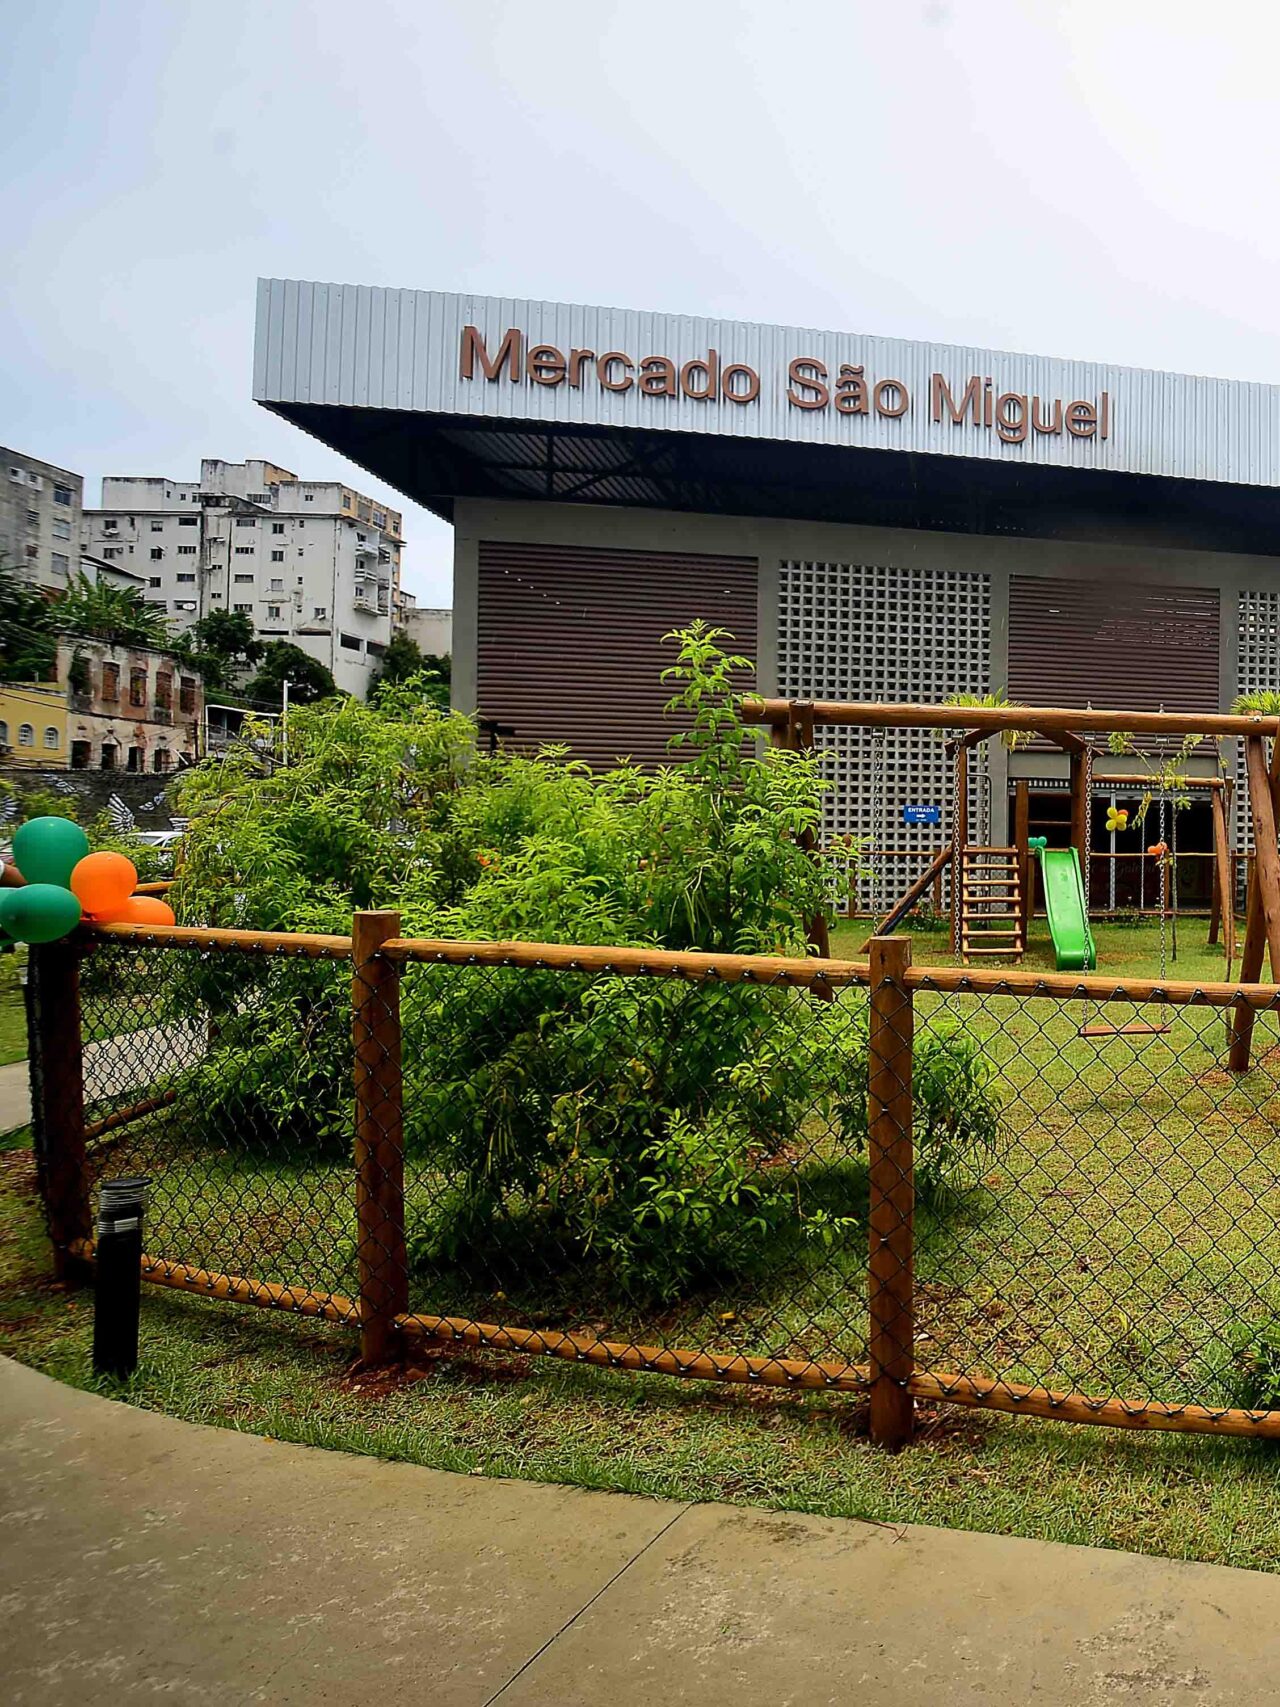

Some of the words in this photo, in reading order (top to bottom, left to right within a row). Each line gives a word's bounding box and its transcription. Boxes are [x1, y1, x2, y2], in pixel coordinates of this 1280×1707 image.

[460, 325, 761, 402] Mercado
[787, 356, 909, 417] São
[931, 372, 1109, 443] Miguel
